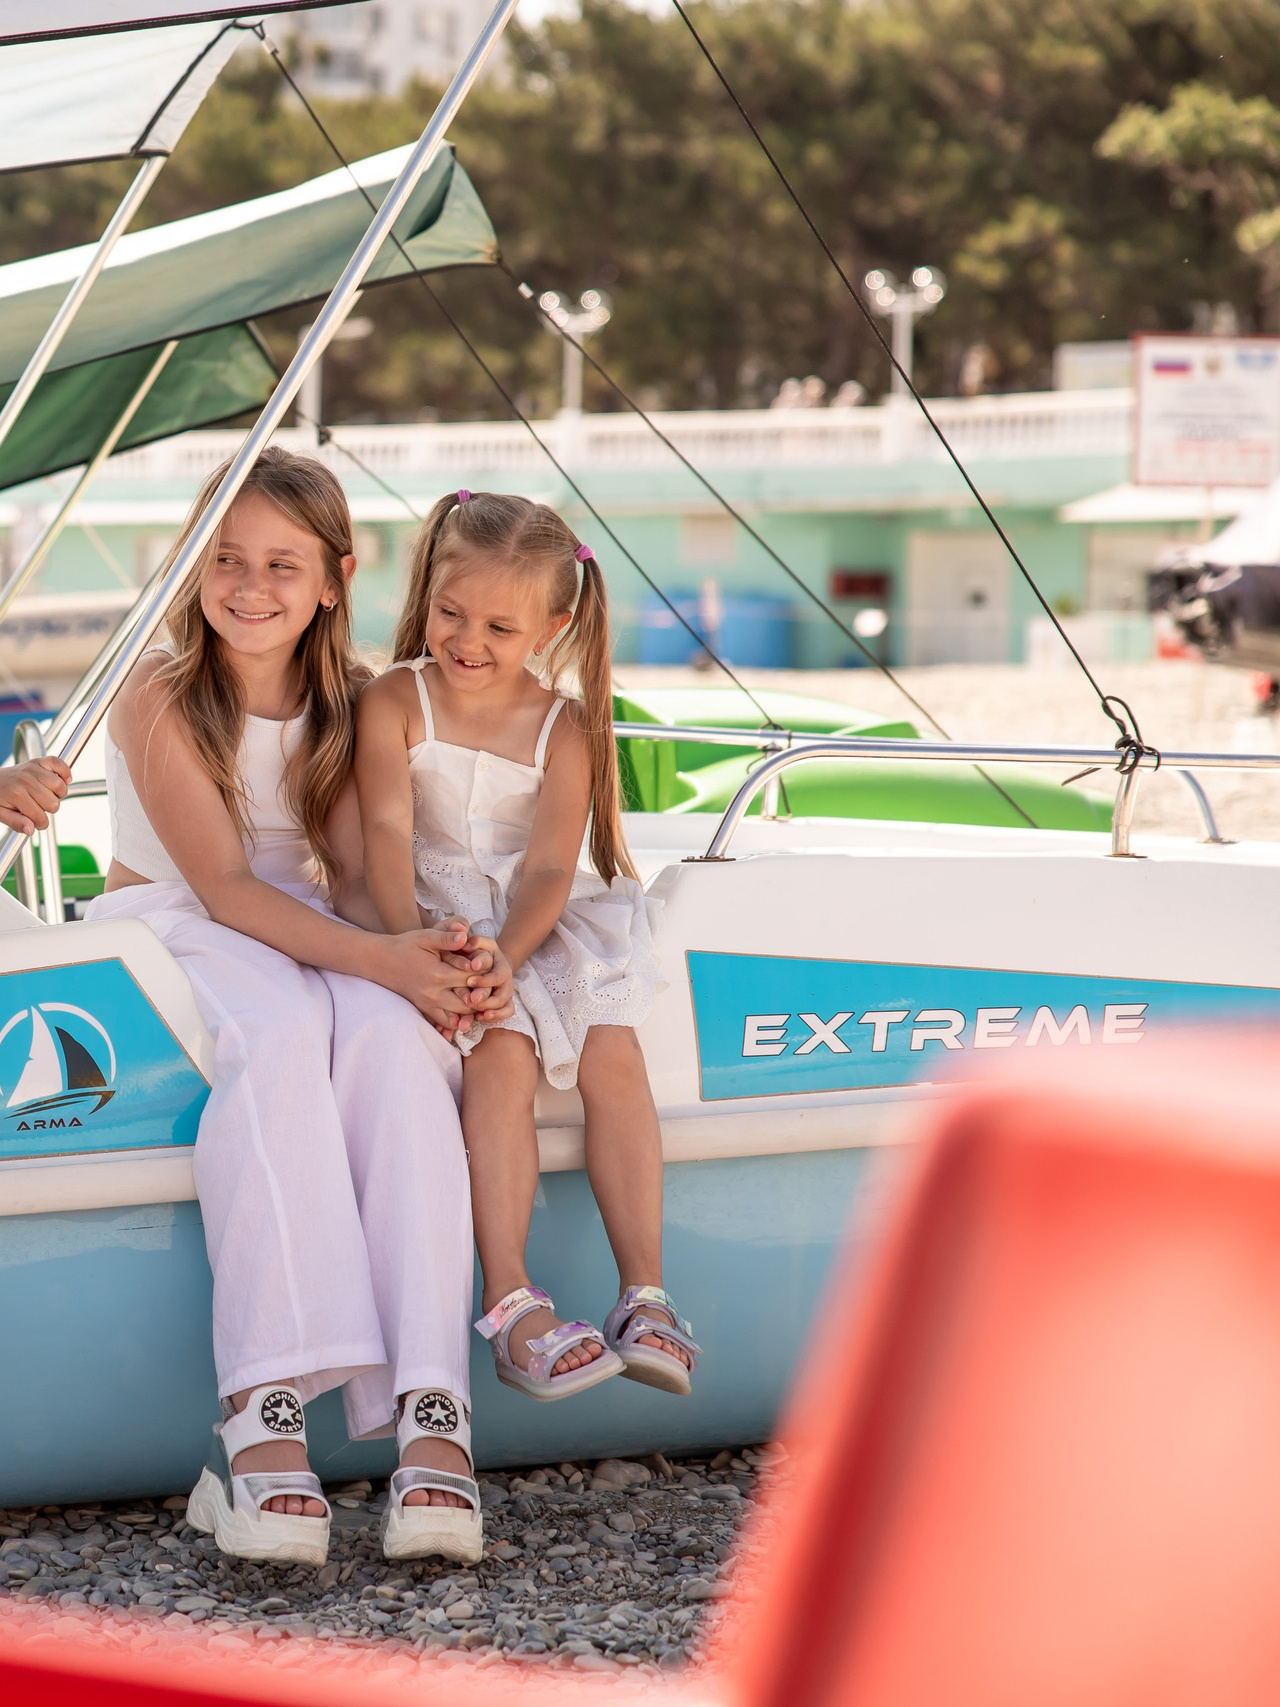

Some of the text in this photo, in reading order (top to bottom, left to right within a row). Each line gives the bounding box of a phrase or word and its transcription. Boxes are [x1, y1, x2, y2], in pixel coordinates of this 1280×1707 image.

[741, 1002, 1150, 1058] EXTREME
[16, 1116, 83, 1132] ARMA
[265, 1393, 300, 1411] FASHION
[419, 1395, 455, 1412] FASHION
[269, 1421, 302, 1432] SPORTS
[421, 1420, 455, 1432] SPORTS
